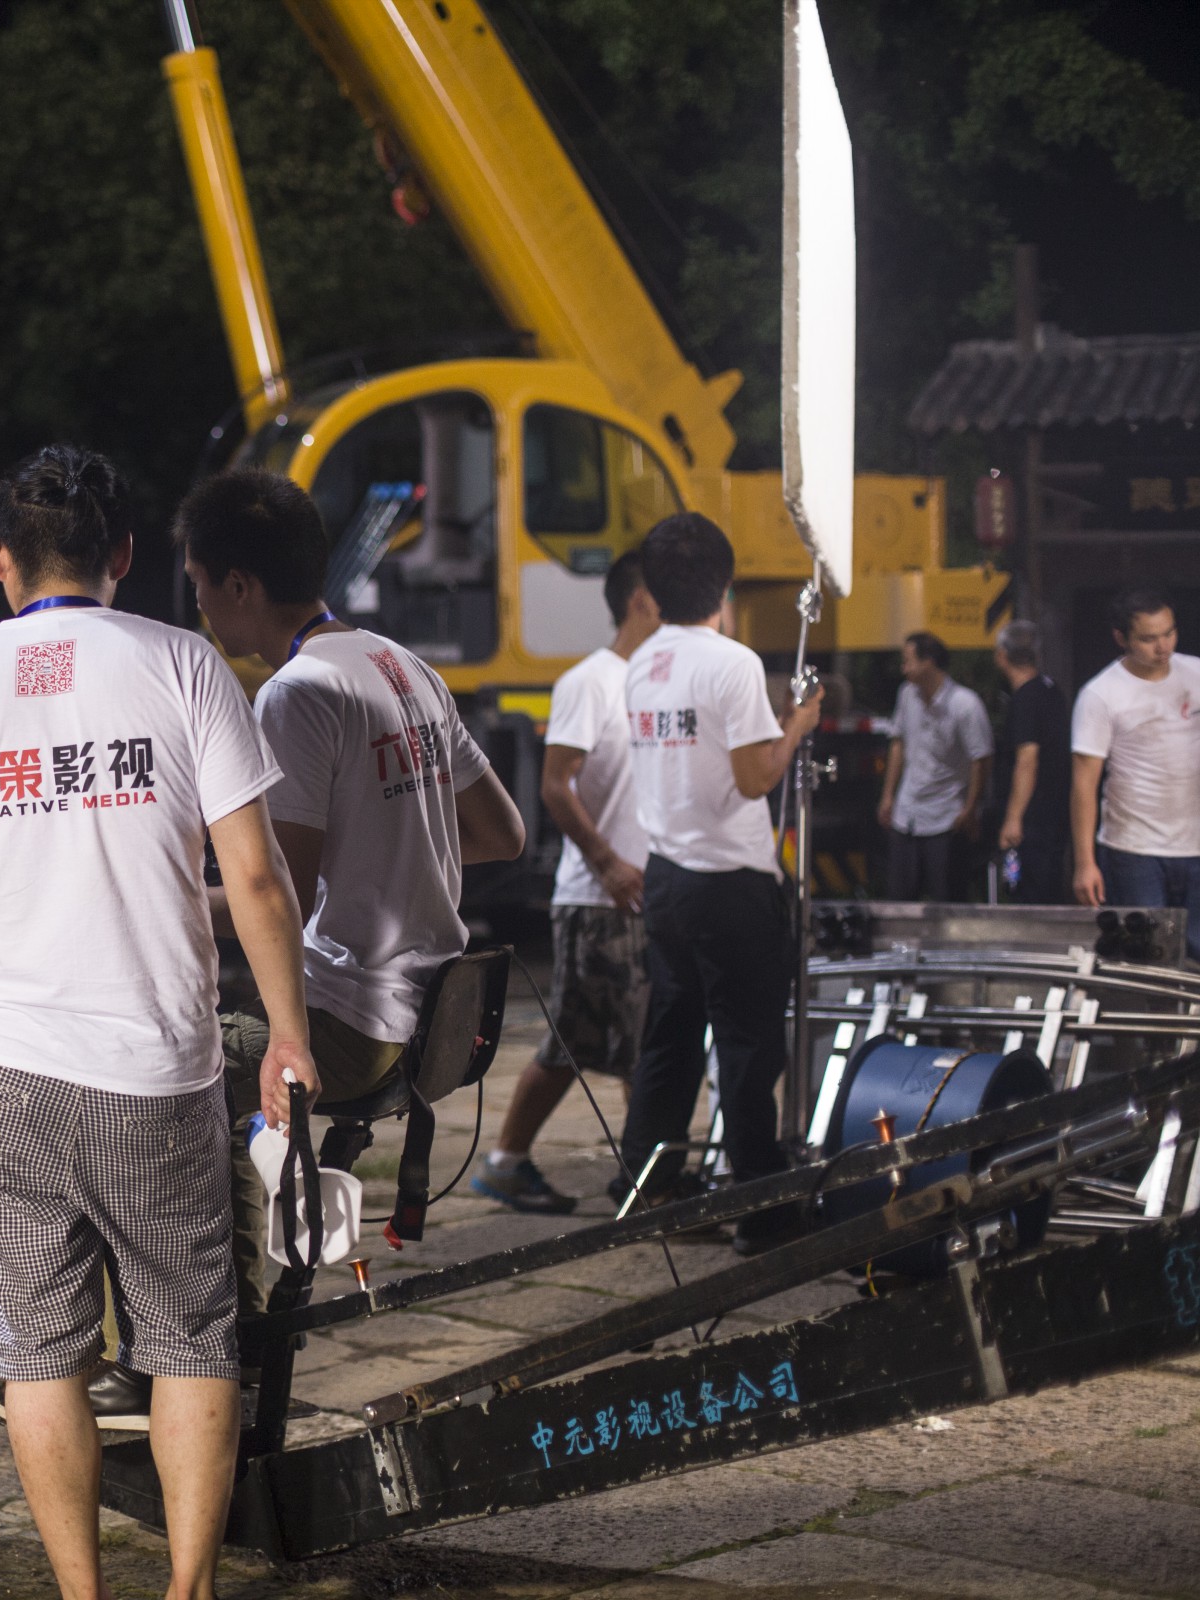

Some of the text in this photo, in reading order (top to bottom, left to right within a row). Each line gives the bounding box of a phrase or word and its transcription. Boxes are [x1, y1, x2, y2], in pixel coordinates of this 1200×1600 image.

[371, 721, 445, 782] 六影
[82, 790, 158, 810] MEDIA
[531, 1361, 799, 1469] 中元影视设备公司
